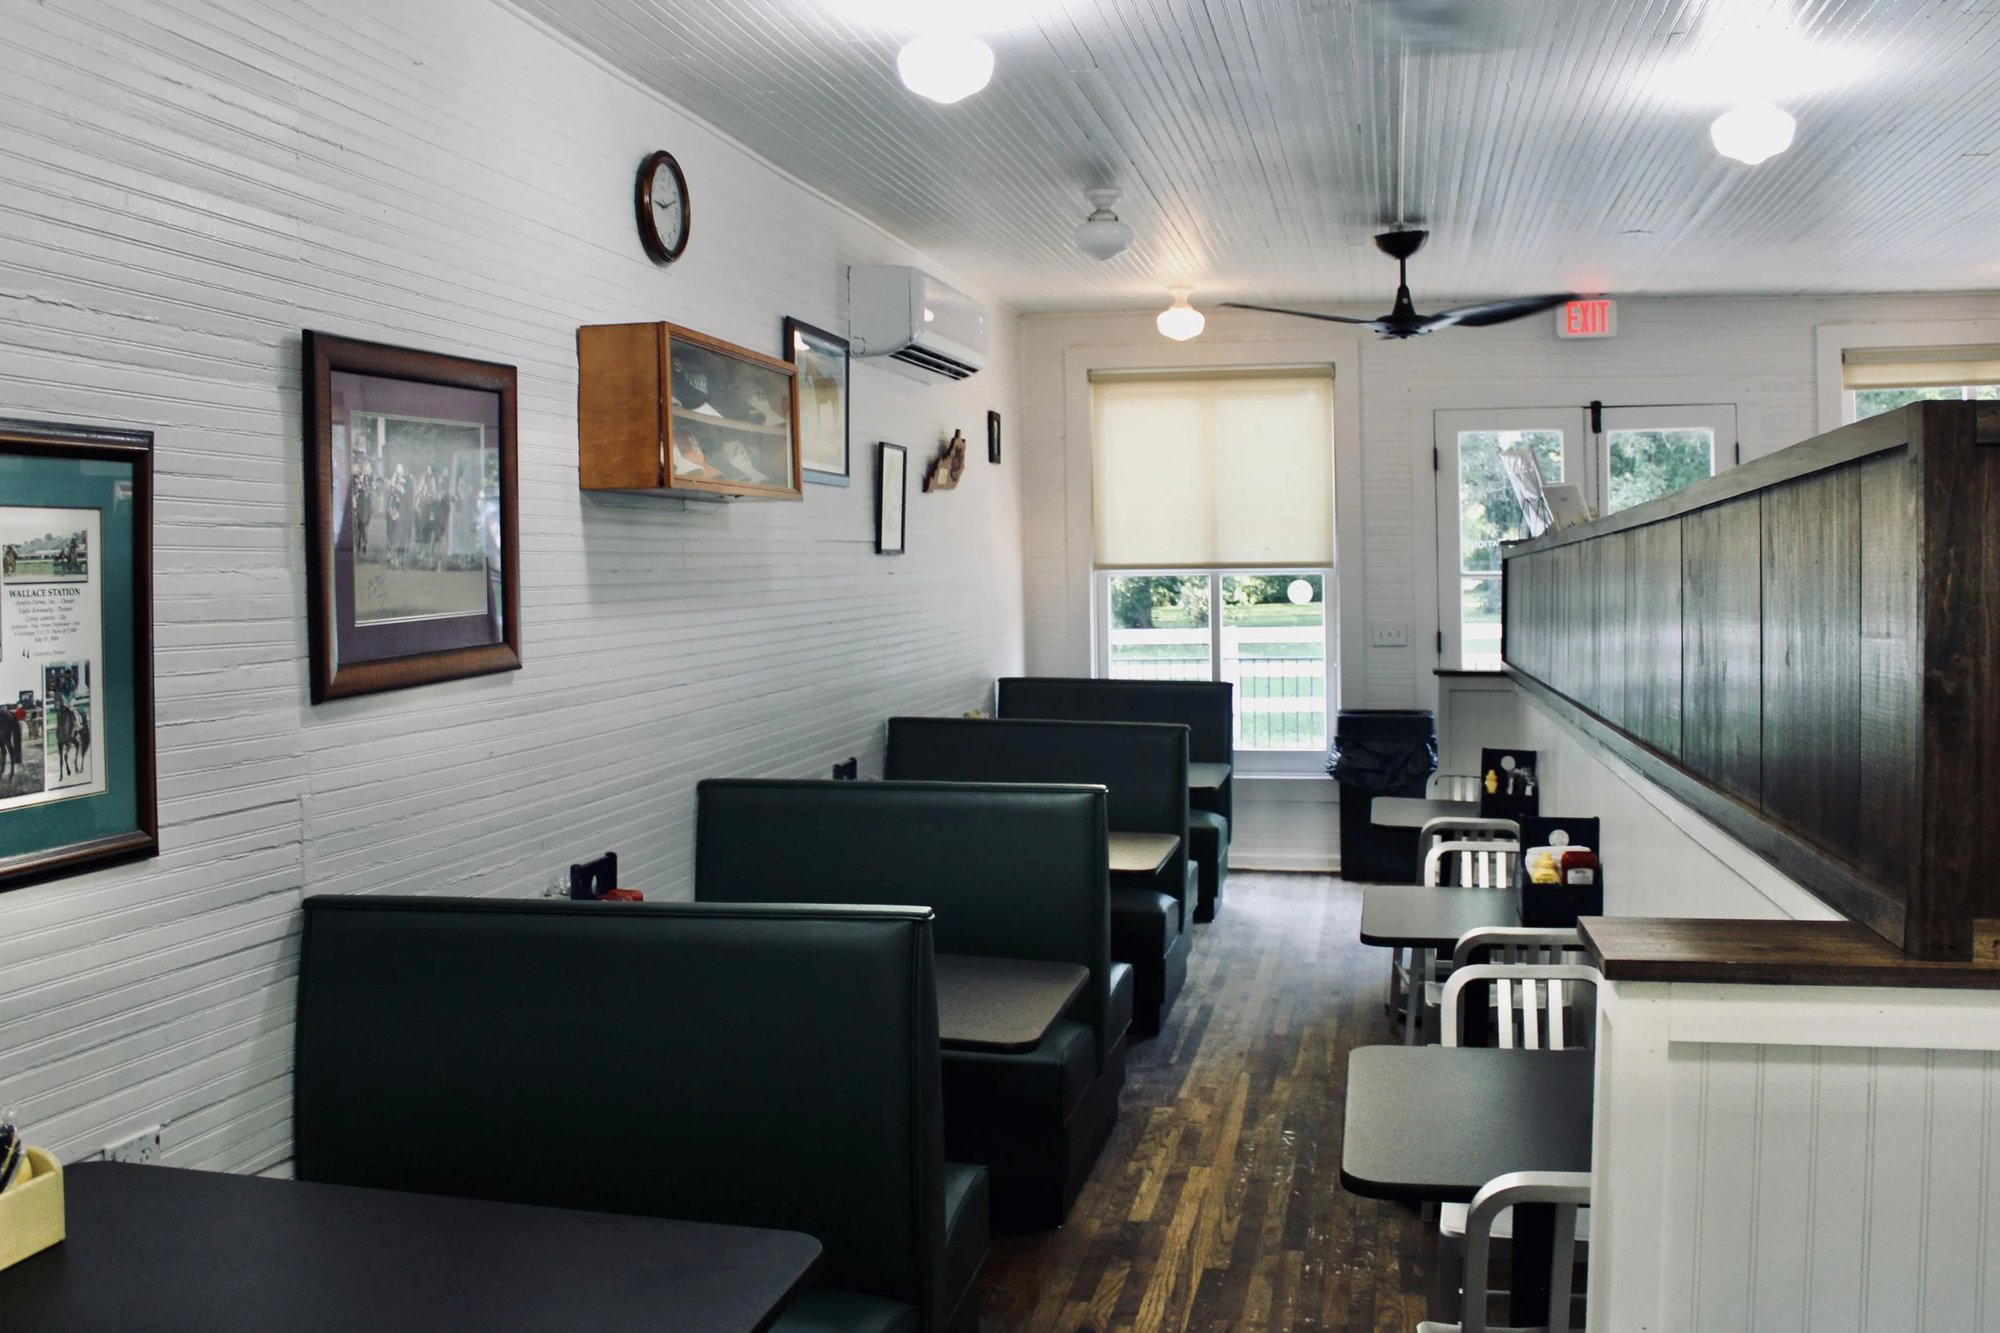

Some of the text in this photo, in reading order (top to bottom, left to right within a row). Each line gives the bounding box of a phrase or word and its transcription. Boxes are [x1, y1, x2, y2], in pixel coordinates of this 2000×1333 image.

[1566, 301, 1608, 334] EXIT
[9, 587, 81, 598] WALLACE STATION
